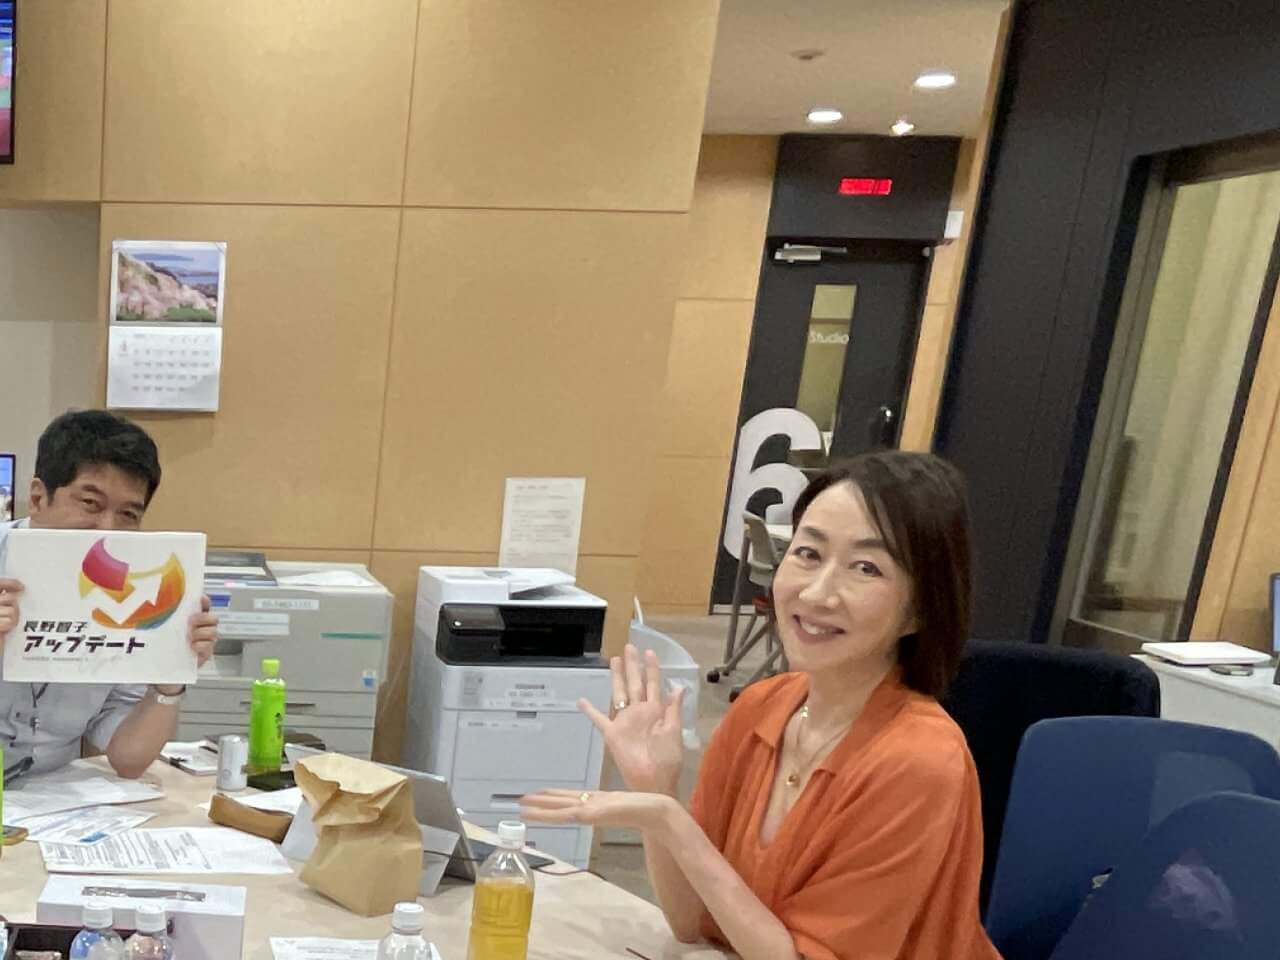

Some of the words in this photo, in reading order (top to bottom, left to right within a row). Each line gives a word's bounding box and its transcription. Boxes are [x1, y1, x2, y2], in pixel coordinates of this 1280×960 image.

[808, 329, 850, 345] Studio
[23, 634, 146, 654] アップデート
